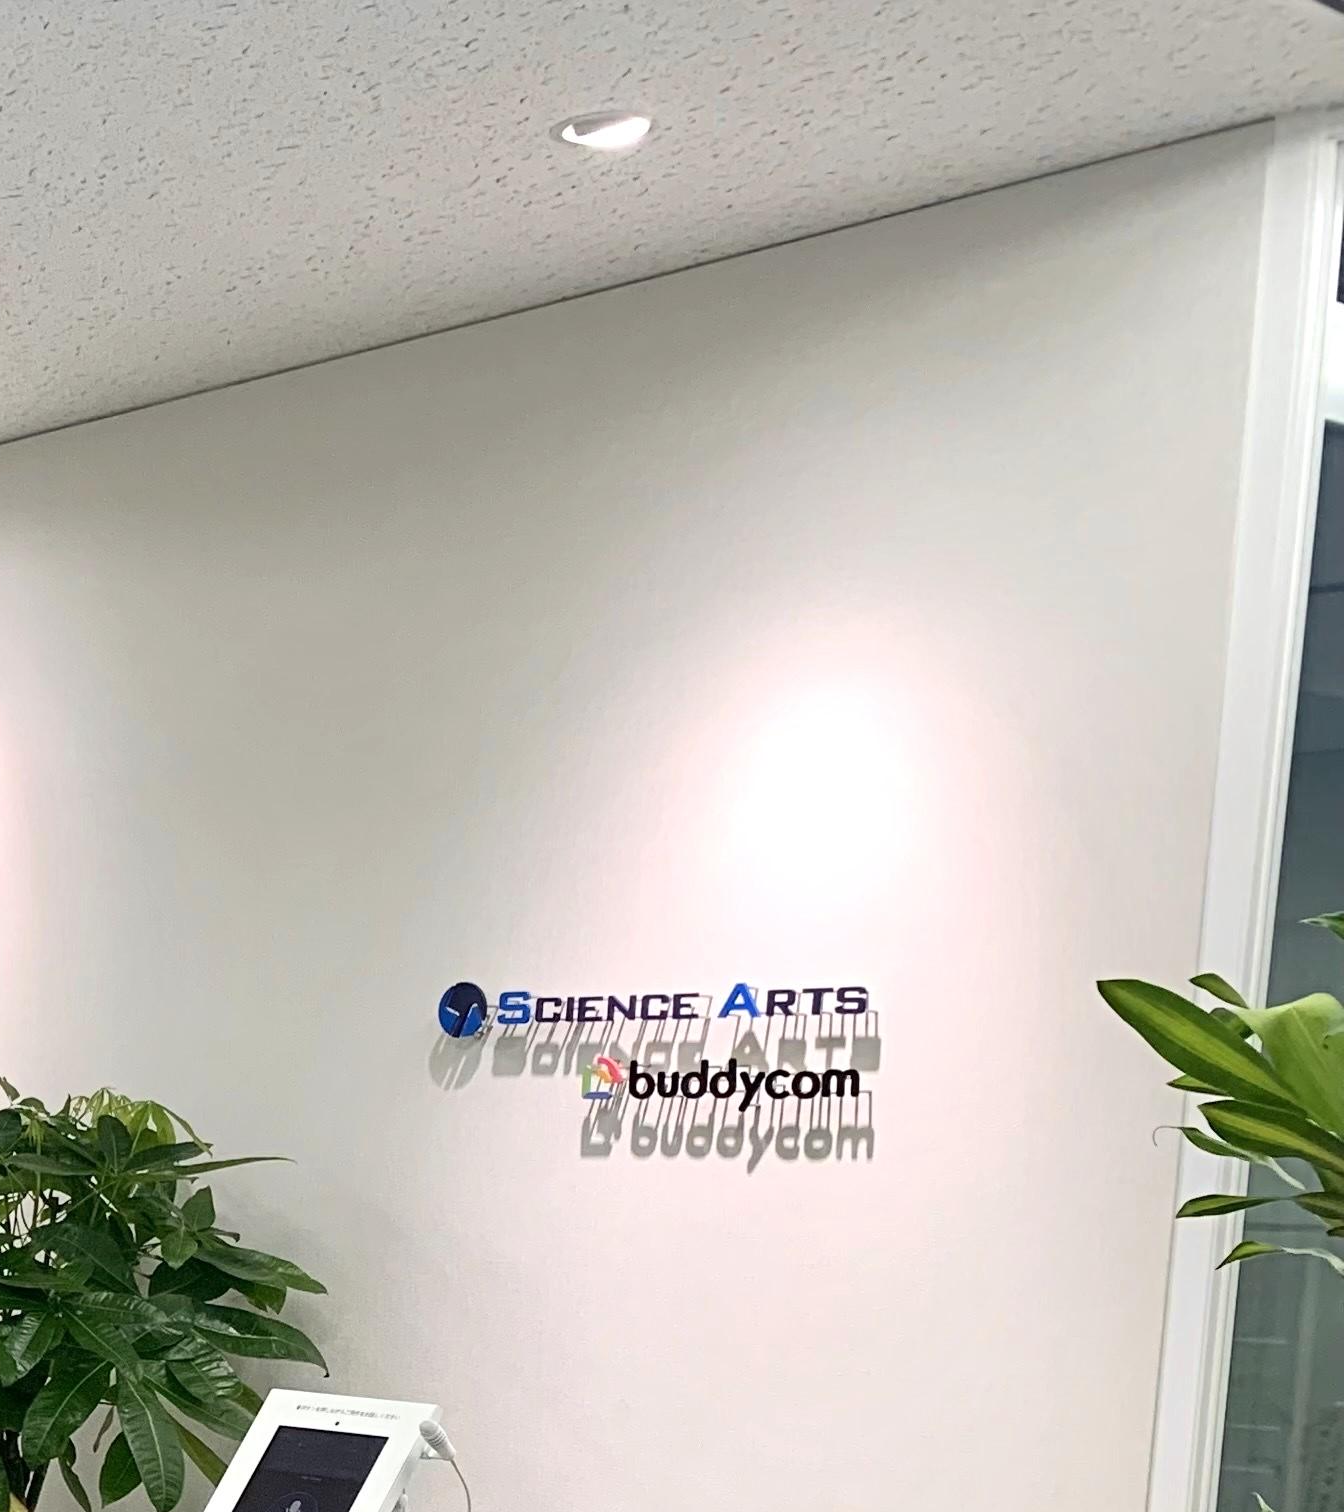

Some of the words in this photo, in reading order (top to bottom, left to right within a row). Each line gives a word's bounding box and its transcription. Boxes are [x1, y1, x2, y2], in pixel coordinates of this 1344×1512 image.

[497, 990, 700, 1024] SCIENCE
[718, 982, 869, 1018] ARTS
[628, 1058, 860, 1112] buddycom
